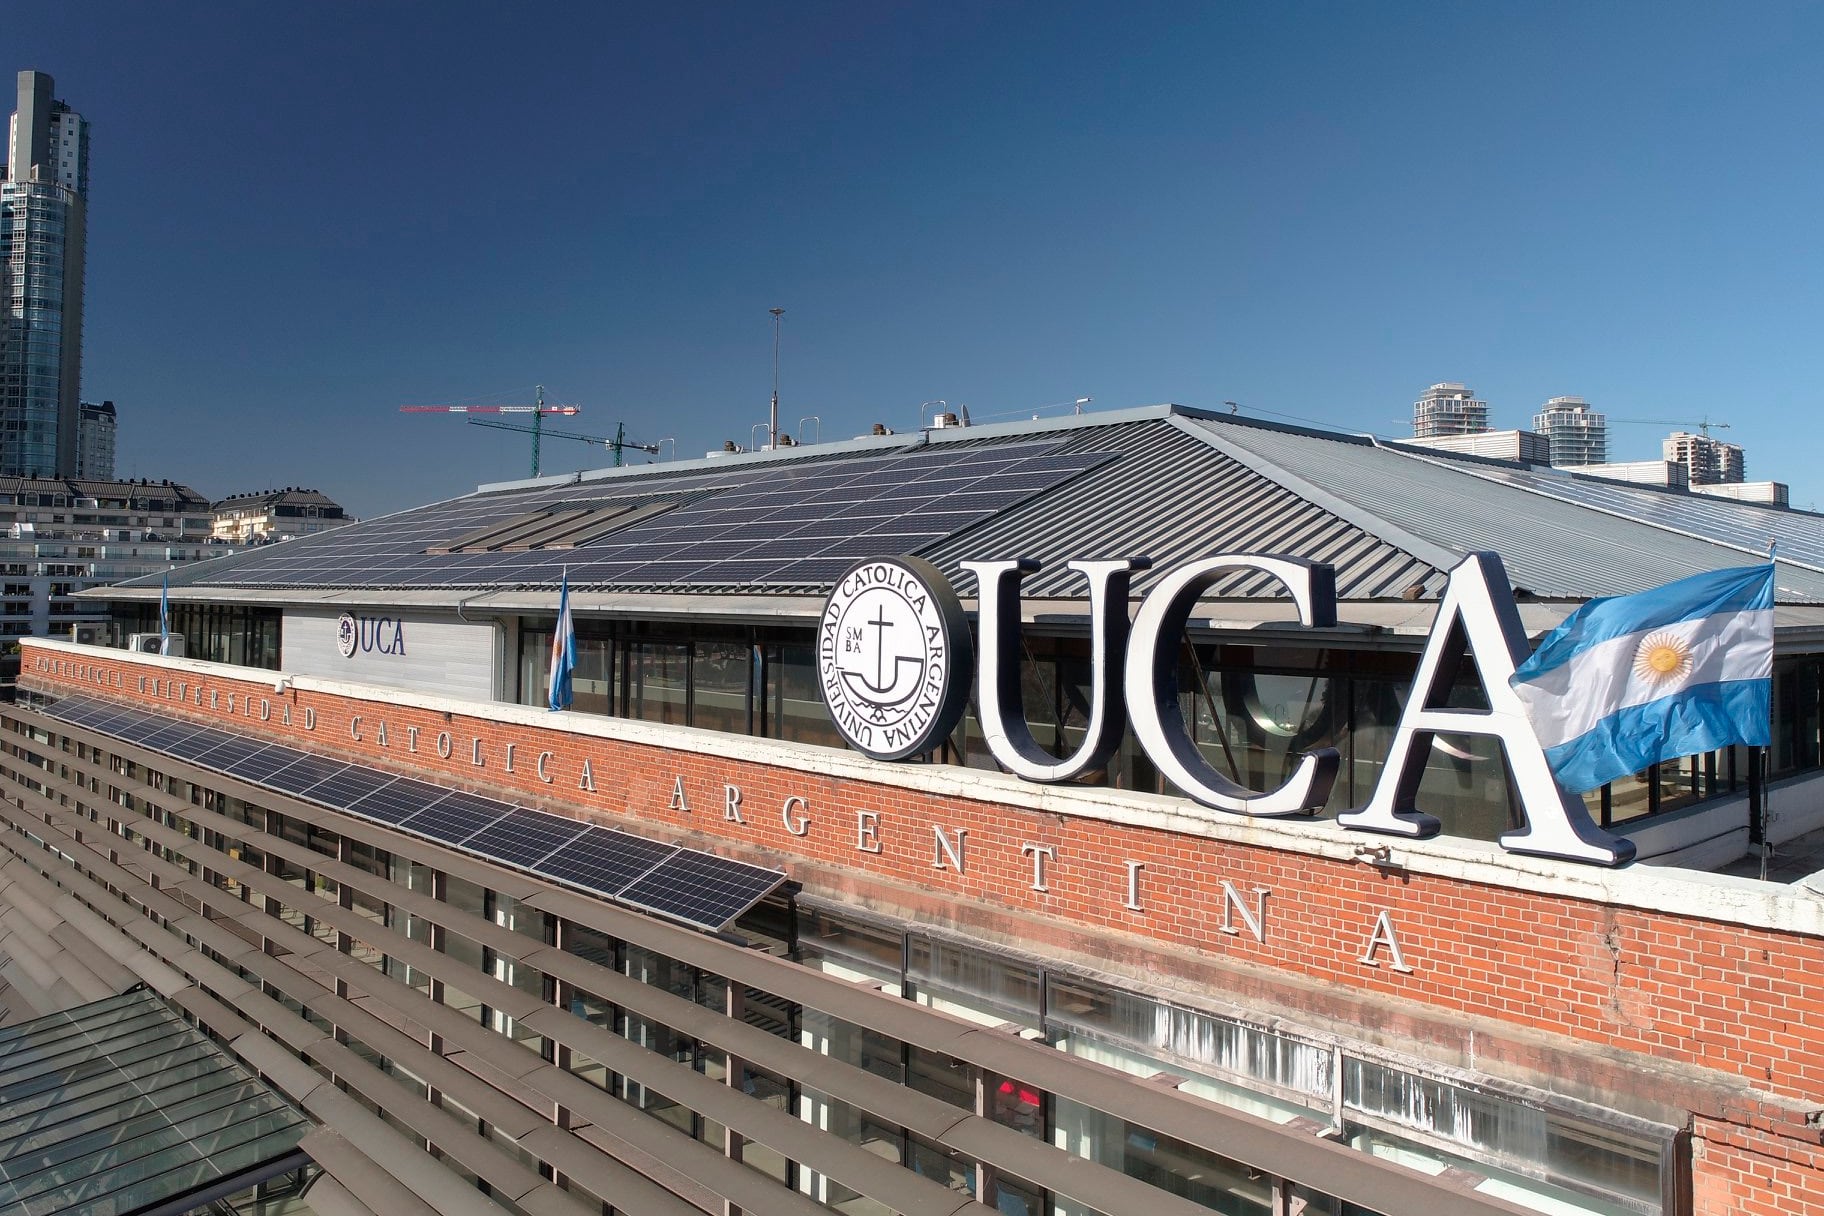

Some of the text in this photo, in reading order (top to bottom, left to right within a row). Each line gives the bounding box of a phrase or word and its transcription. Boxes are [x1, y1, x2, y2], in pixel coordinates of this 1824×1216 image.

[360, 616, 407, 656] UCA
[823, 565, 943, 749] UNIVERSIDAD CATOLICA ARGENTINA
[845, 640, 861, 654] BA
[959, 551, 1635, 866] UCA
[36, 656, 1414, 974] PONTIFICIA UNIVERSIDAD CATOLICA ARGENTINA
